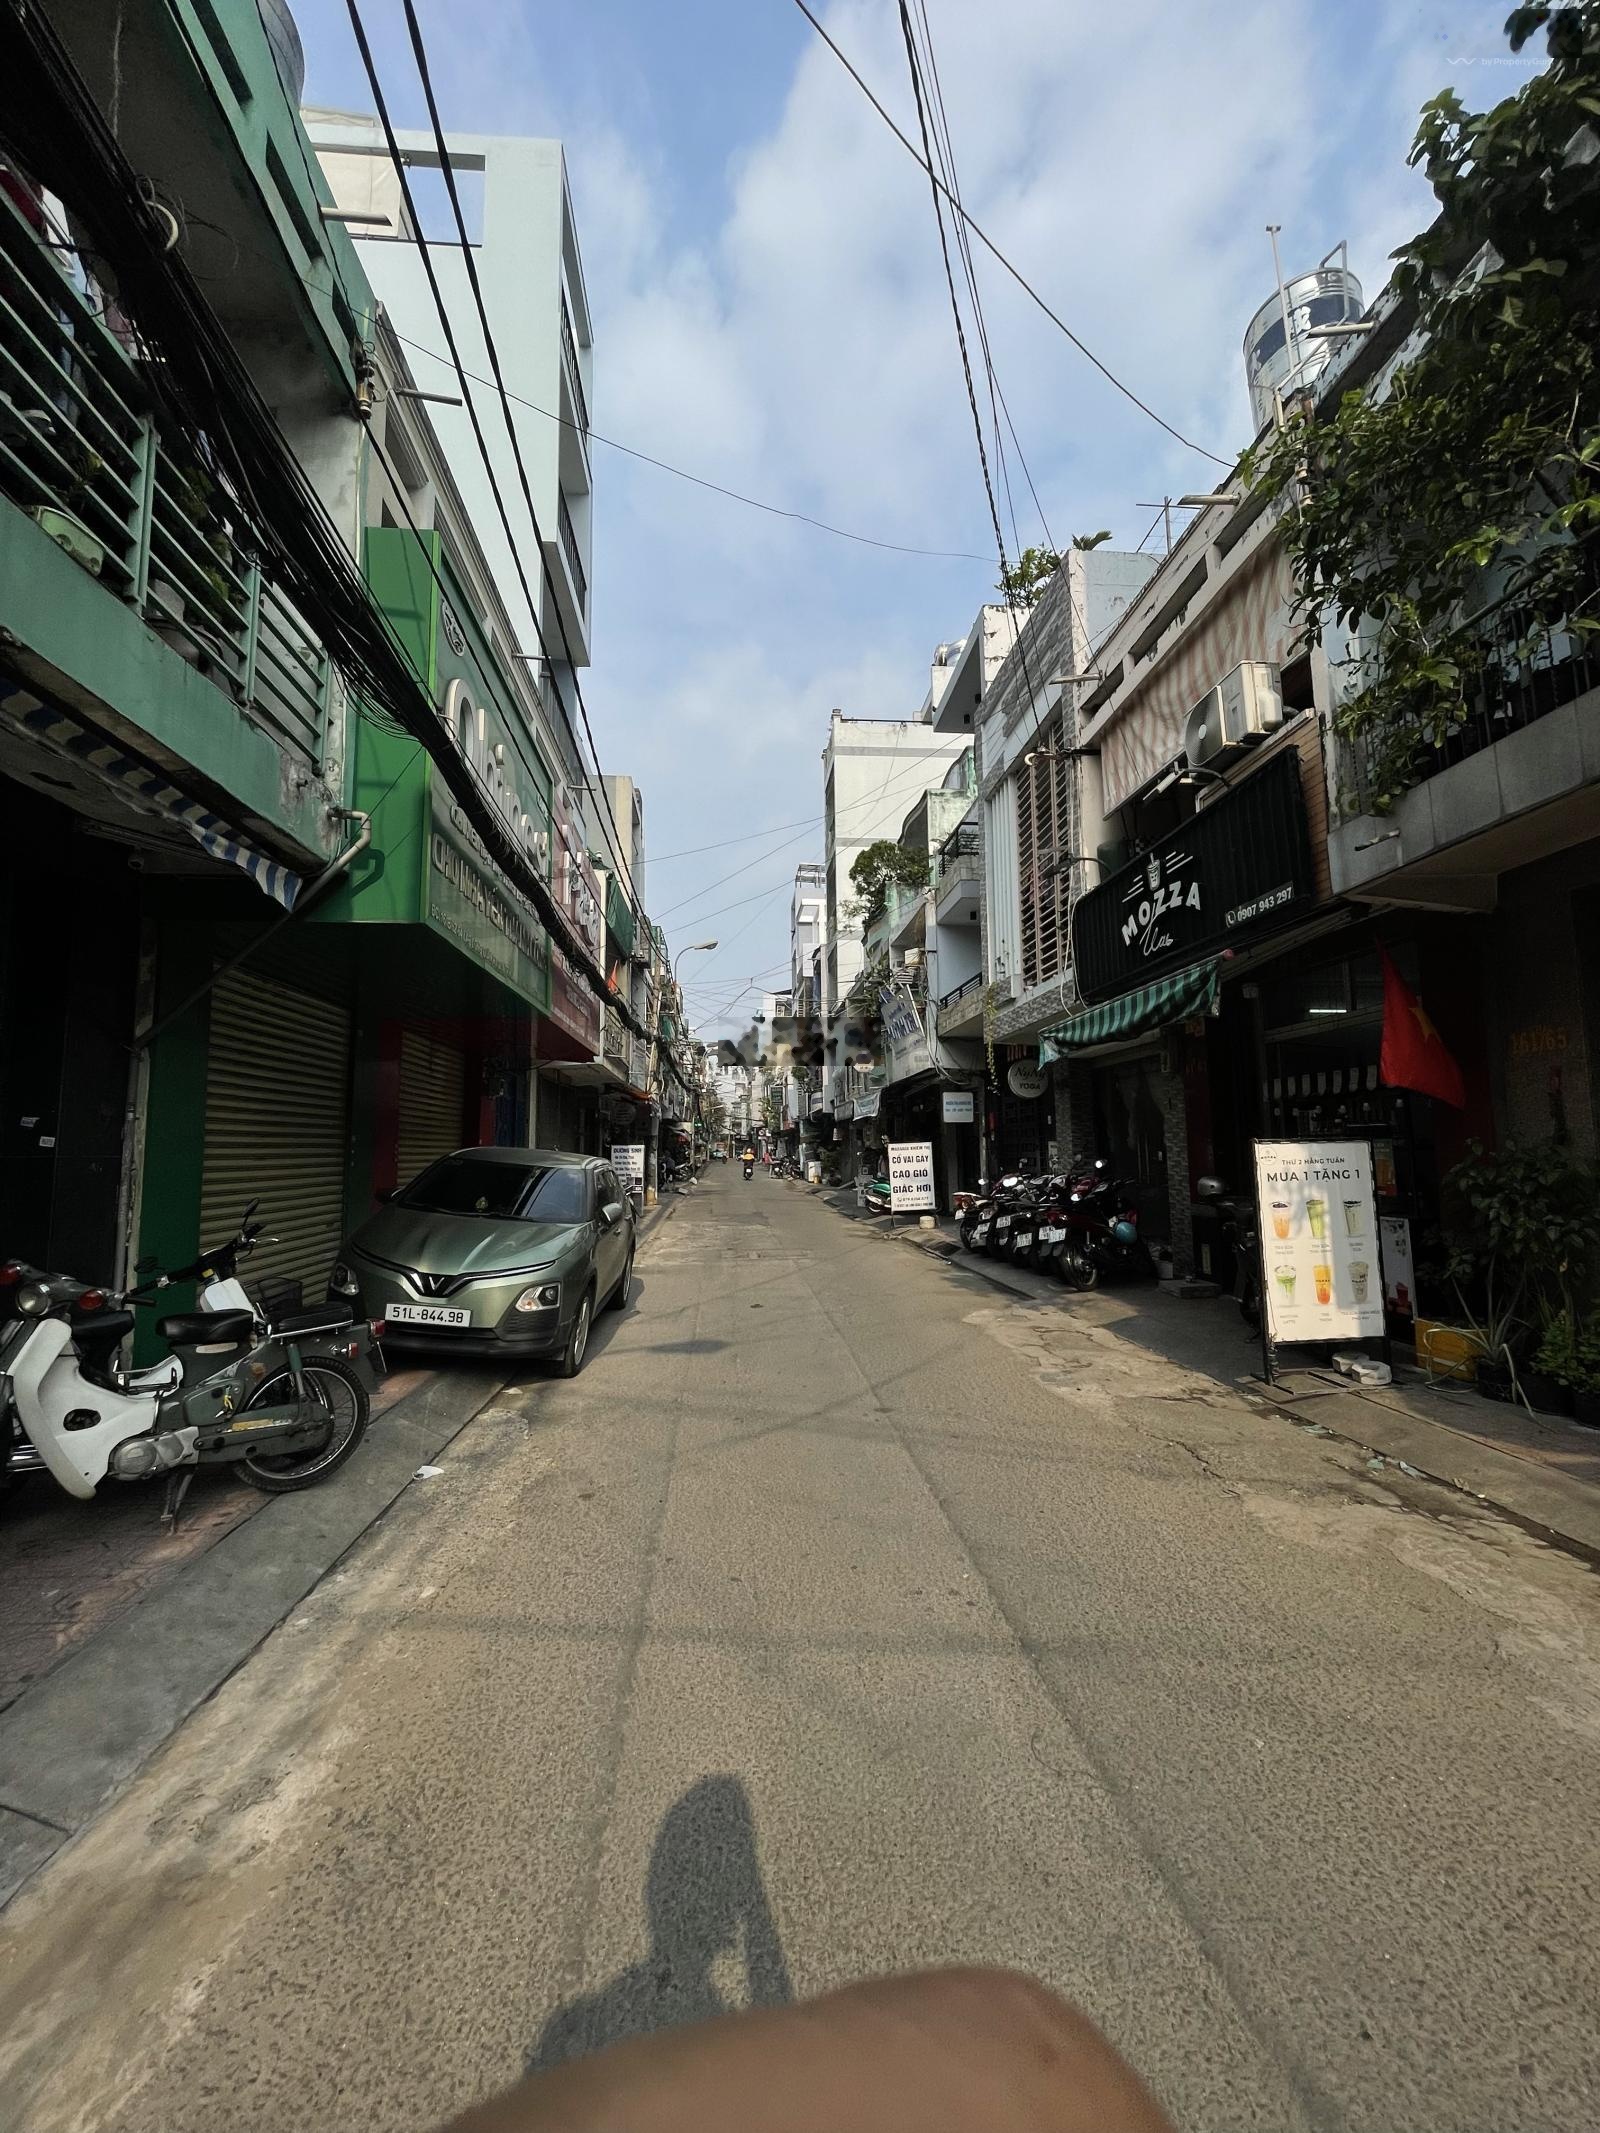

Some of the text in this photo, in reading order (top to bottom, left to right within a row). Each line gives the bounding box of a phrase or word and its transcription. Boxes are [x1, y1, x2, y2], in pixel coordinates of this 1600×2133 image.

[1237, 887, 1292, 922] 0907 943 297
[1121, 880, 1201, 947] MOZZA
[1019, 1082, 1041, 1090] YOGA
[902, 1155, 914, 1163] VAI
[1266, 1168, 1360, 1183] MUA 1 TẶNG 1
[392, 1306, 464, 1323] 51L-844.98
